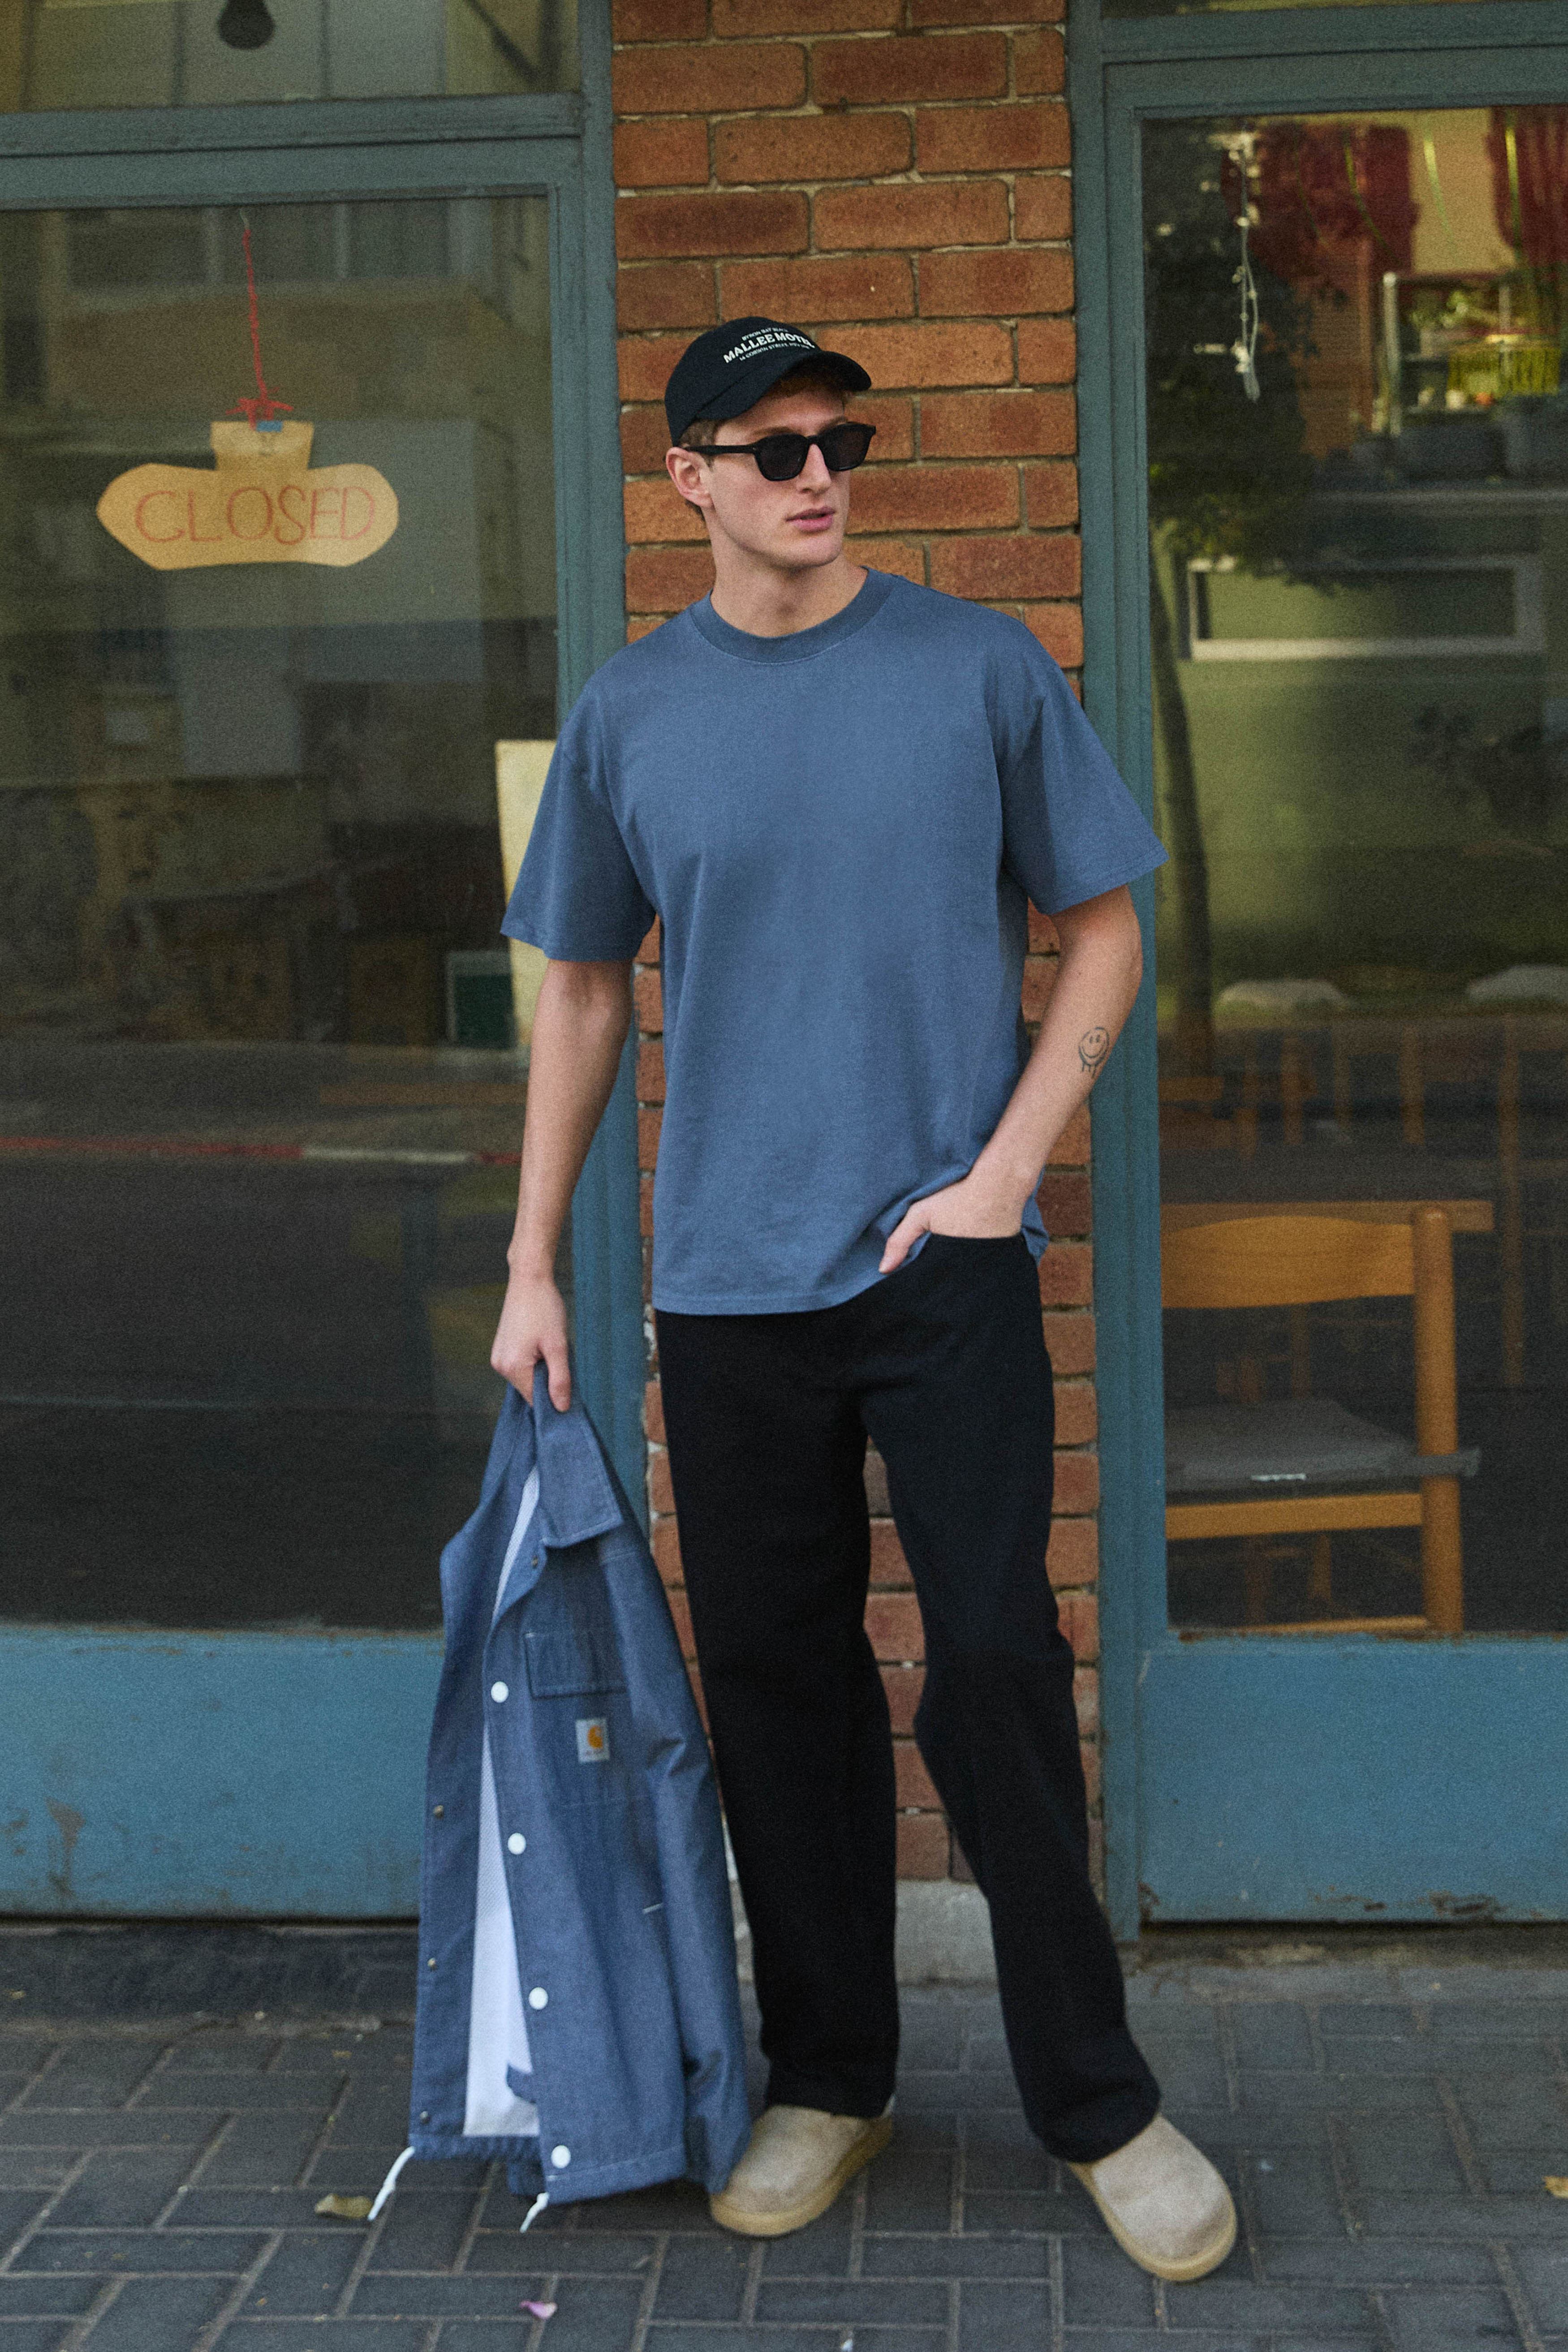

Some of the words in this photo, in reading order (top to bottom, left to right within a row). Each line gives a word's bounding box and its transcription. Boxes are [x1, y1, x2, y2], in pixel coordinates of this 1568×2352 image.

[723, 334, 775, 363] MALLEE
[774, 332, 815, 349] MOTEL
[134, 485, 375, 546] CLOSED
